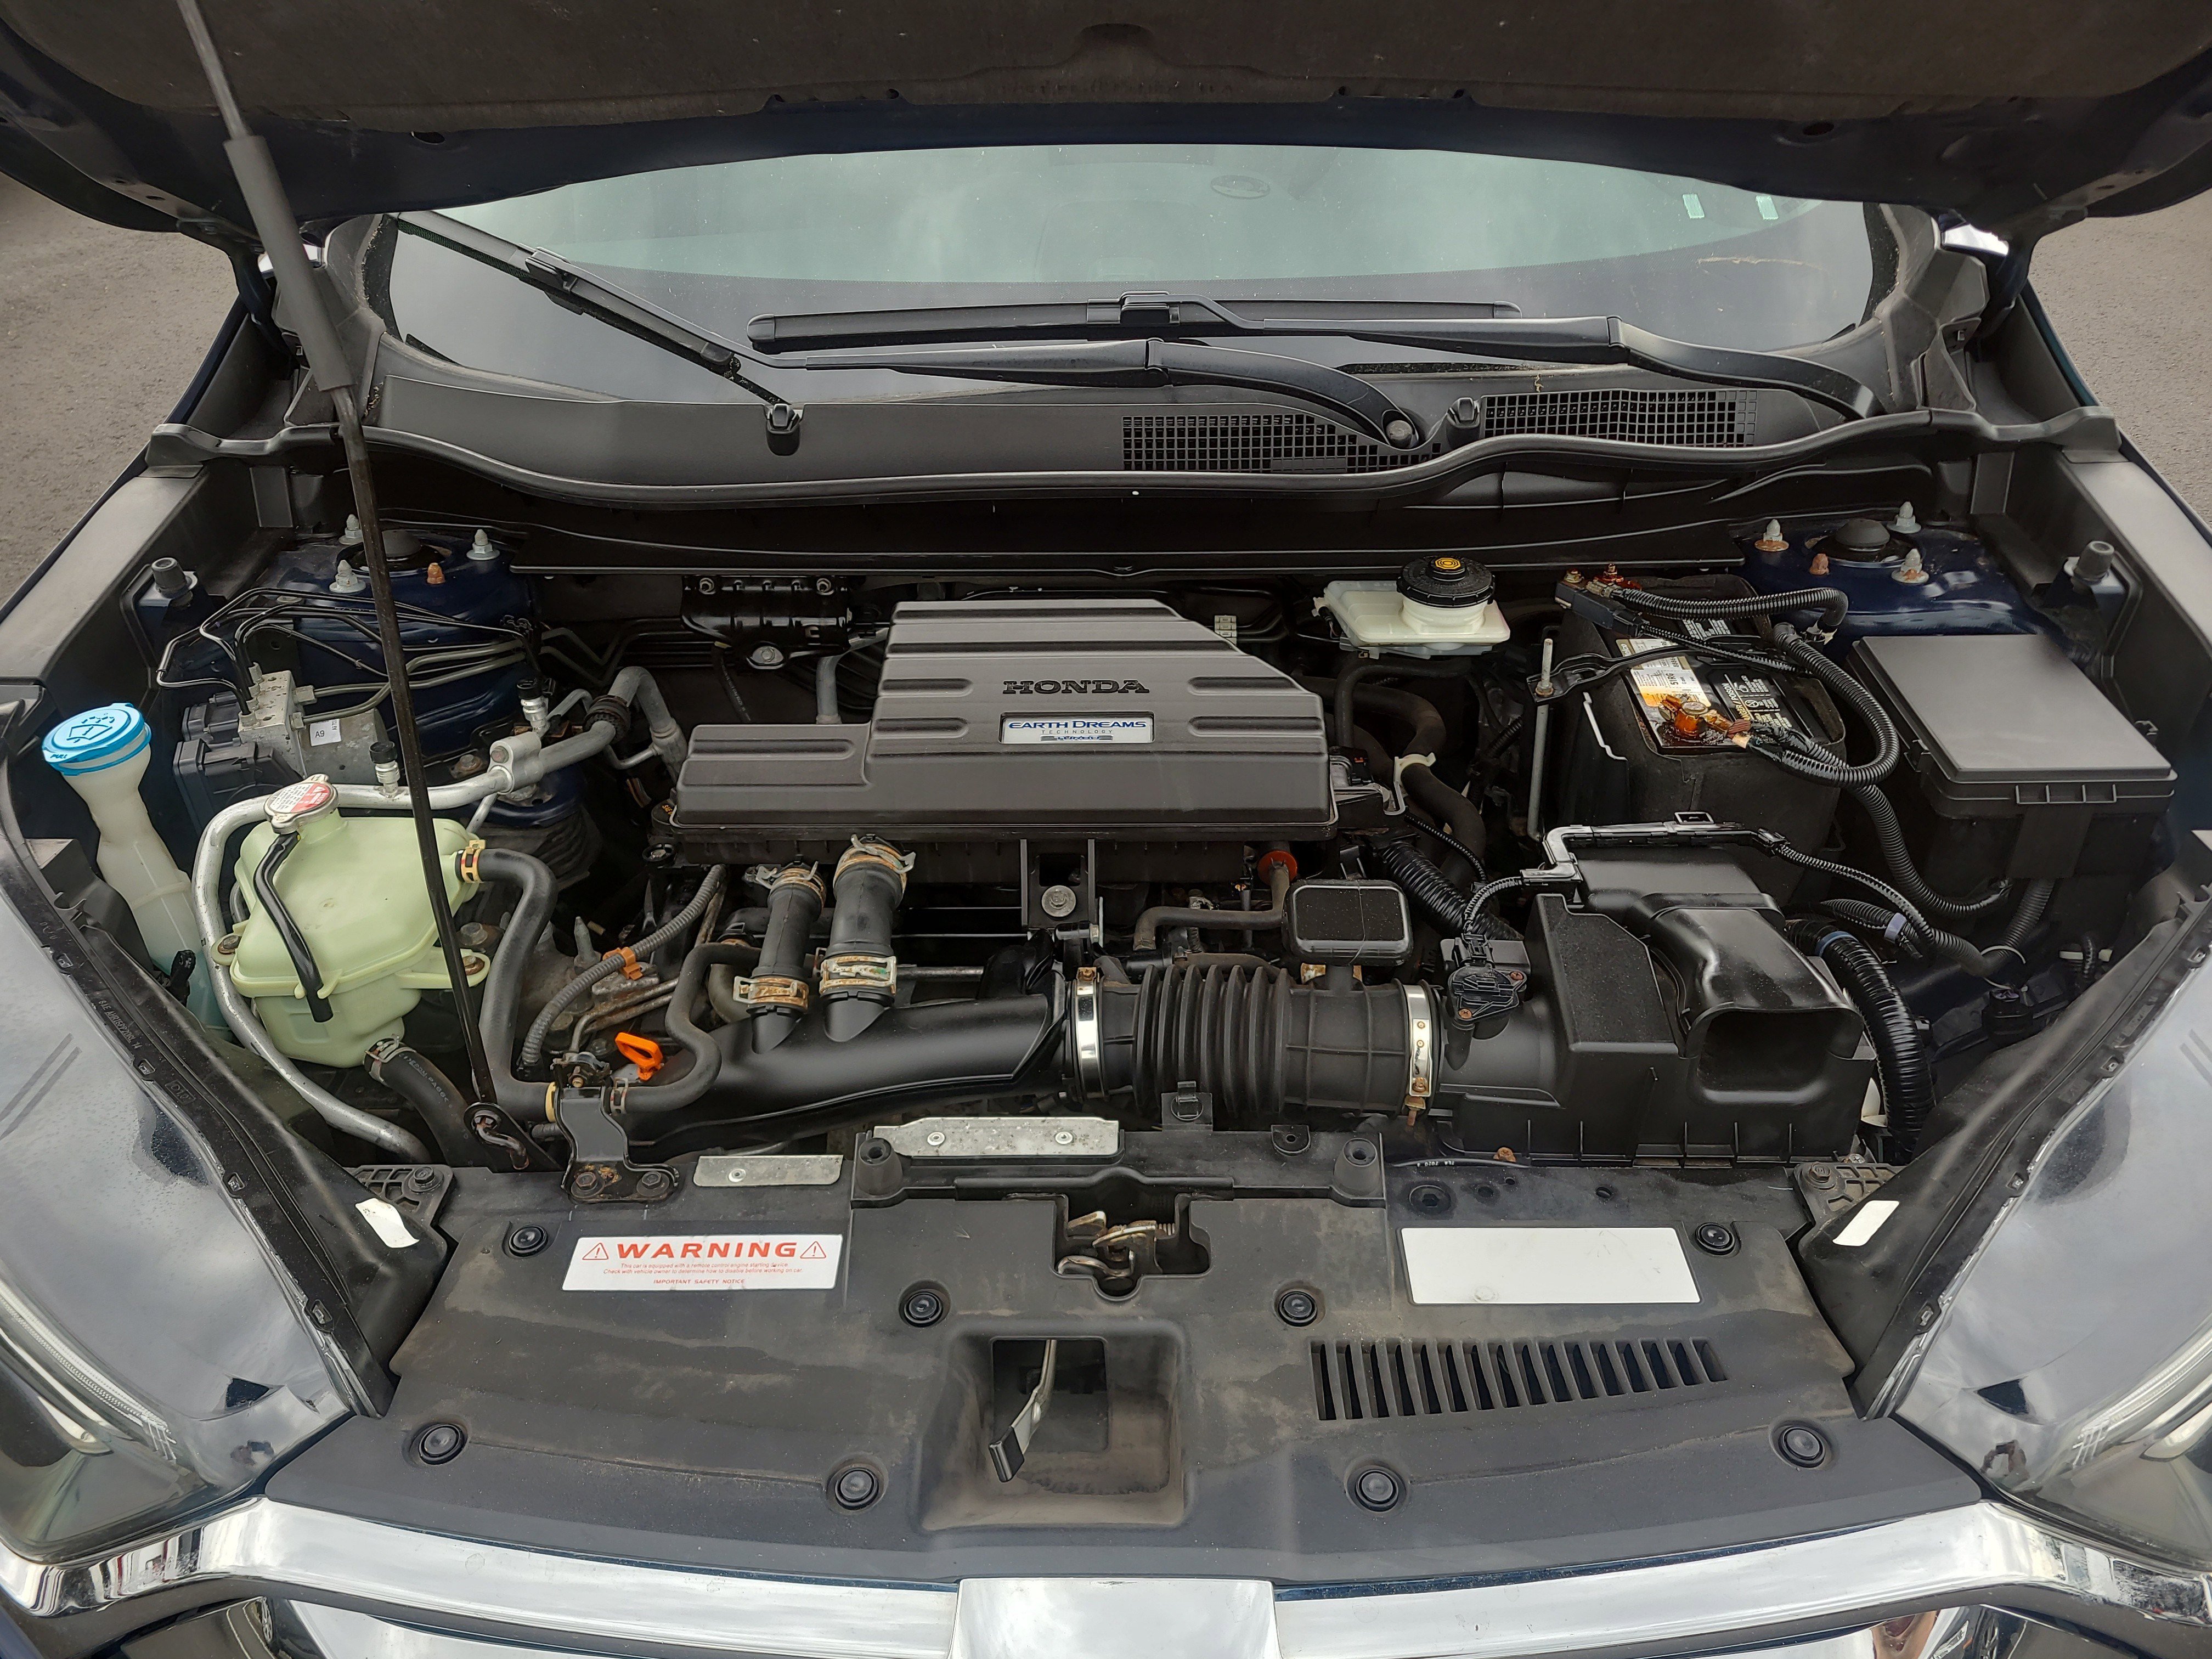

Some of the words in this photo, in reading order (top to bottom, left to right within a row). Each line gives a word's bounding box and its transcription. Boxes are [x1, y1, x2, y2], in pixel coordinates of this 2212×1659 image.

[1003, 680, 1150, 694] HONDA
[1722, 683, 1739, 702] POISON
[1008, 721, 1068, 729] EARTH
[1073, 720, 1147, 729] DREAMS
[617, 1242, 797, 1258] WARNING
